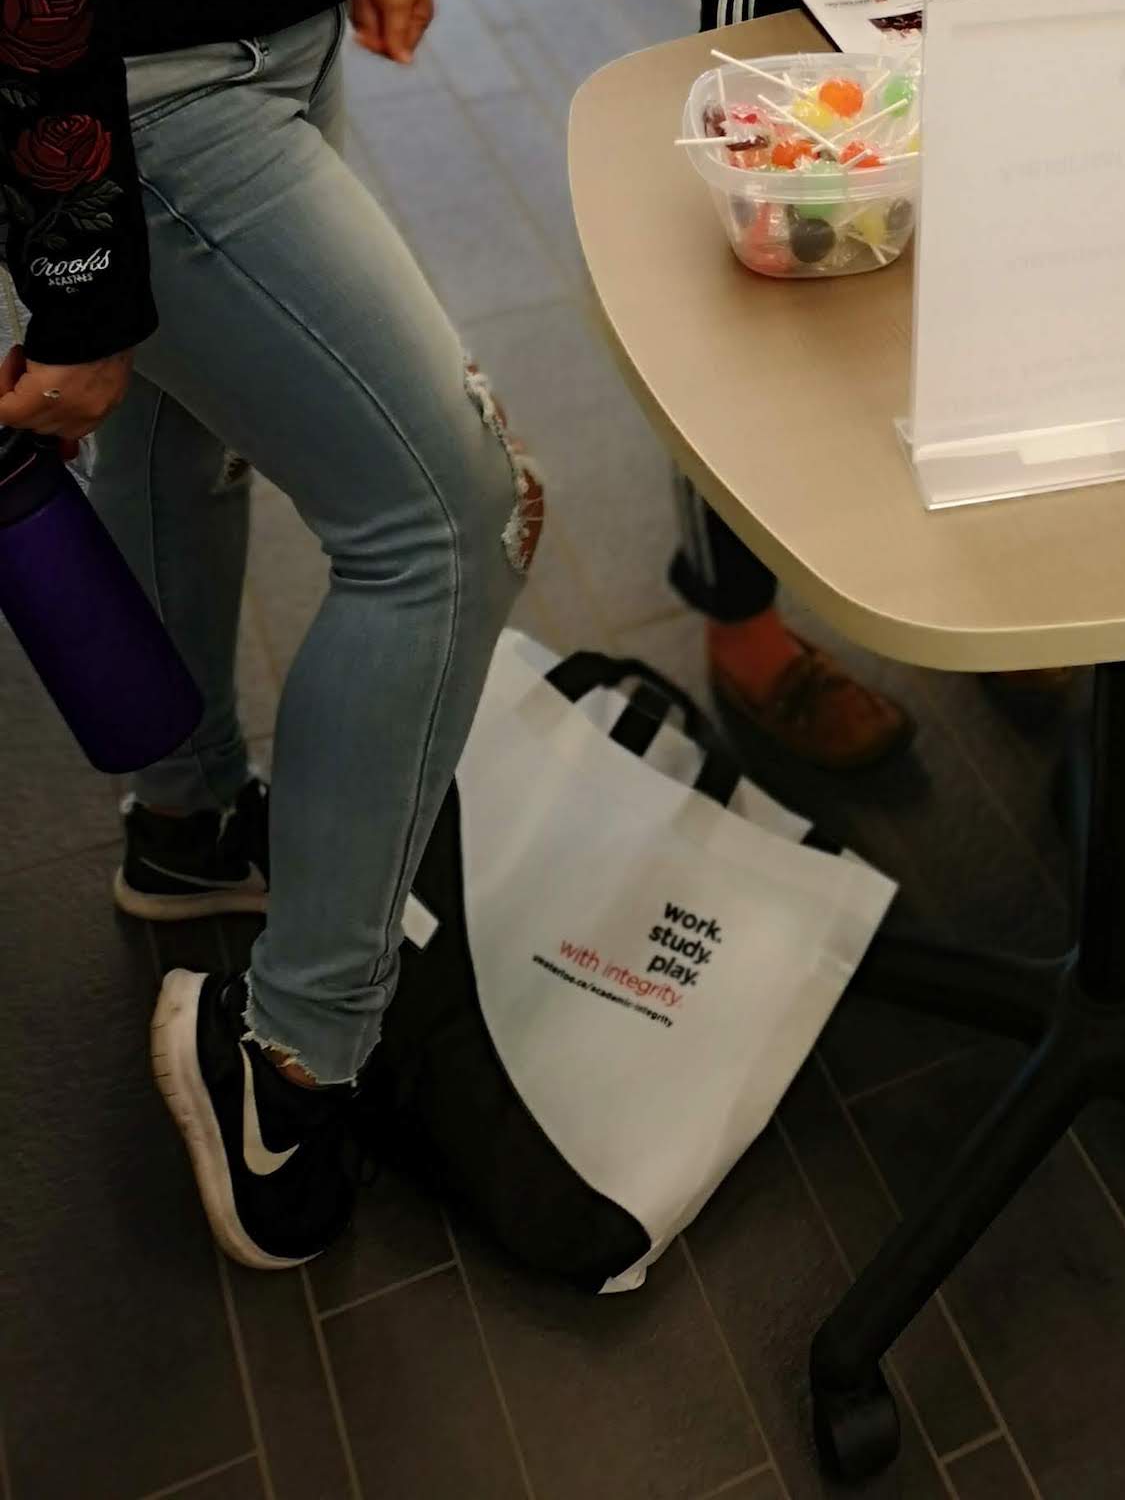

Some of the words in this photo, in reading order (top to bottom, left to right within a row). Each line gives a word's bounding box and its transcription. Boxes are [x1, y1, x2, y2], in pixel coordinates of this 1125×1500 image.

[30, 247, 112, 277] Crooks
[664, 902, 722, 944] work.
[648, 925, 713, 965] study.
[560, 939, 600, 973] with
[603, 959, 683, 1008] integrity.
[646, 955, 700, 986] play.
